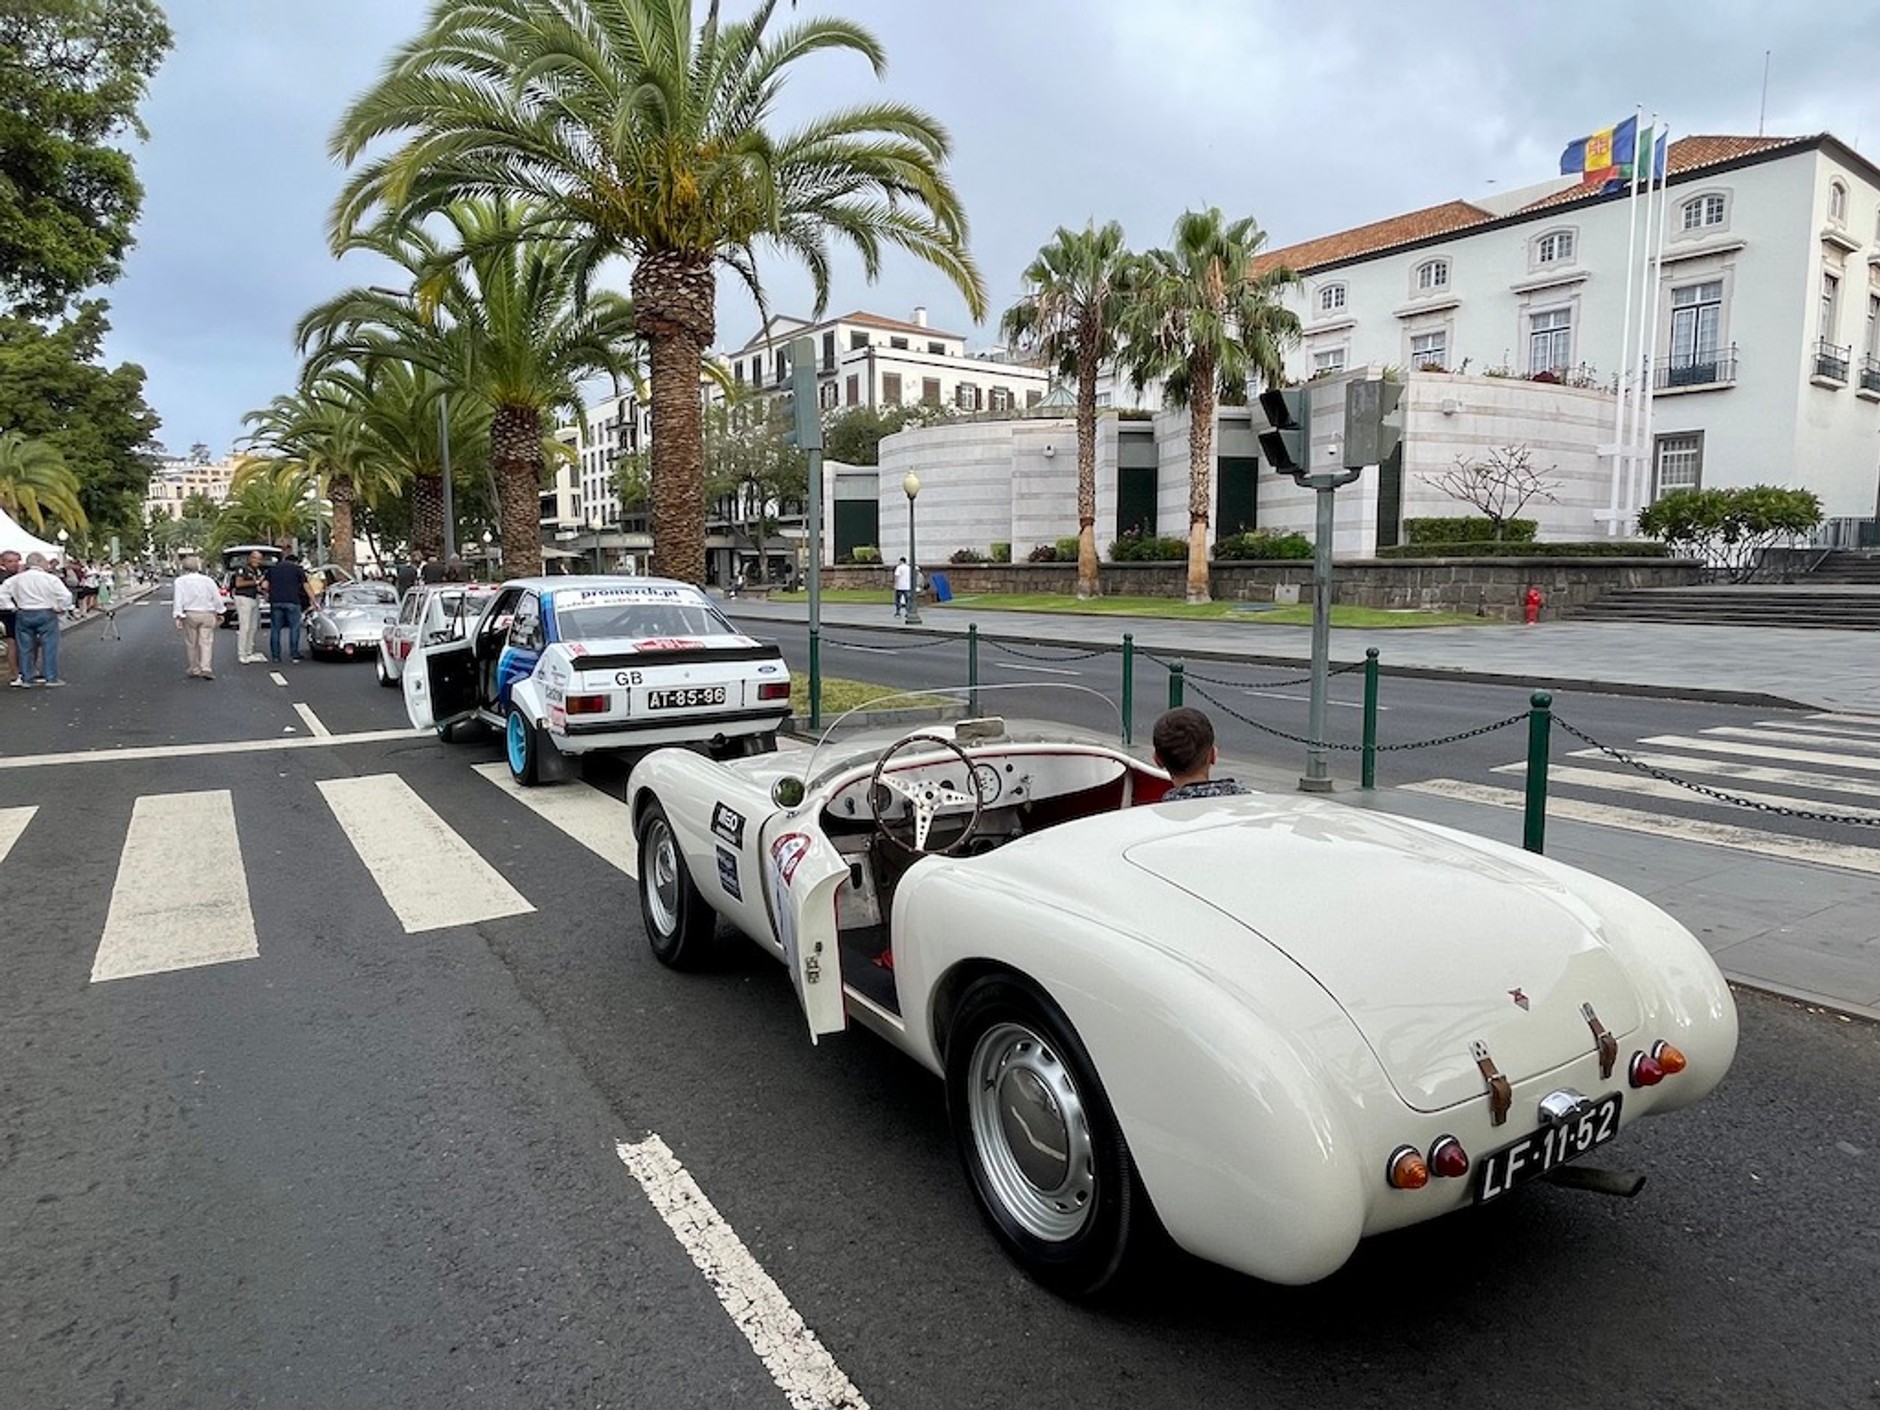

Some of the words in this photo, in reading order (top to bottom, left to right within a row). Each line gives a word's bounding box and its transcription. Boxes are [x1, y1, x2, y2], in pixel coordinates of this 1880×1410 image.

[580, 587, 680, 599] promerch.pt
[615, 671, 643, 686] GB
[649, 688, 725, 708] AT-85-96
